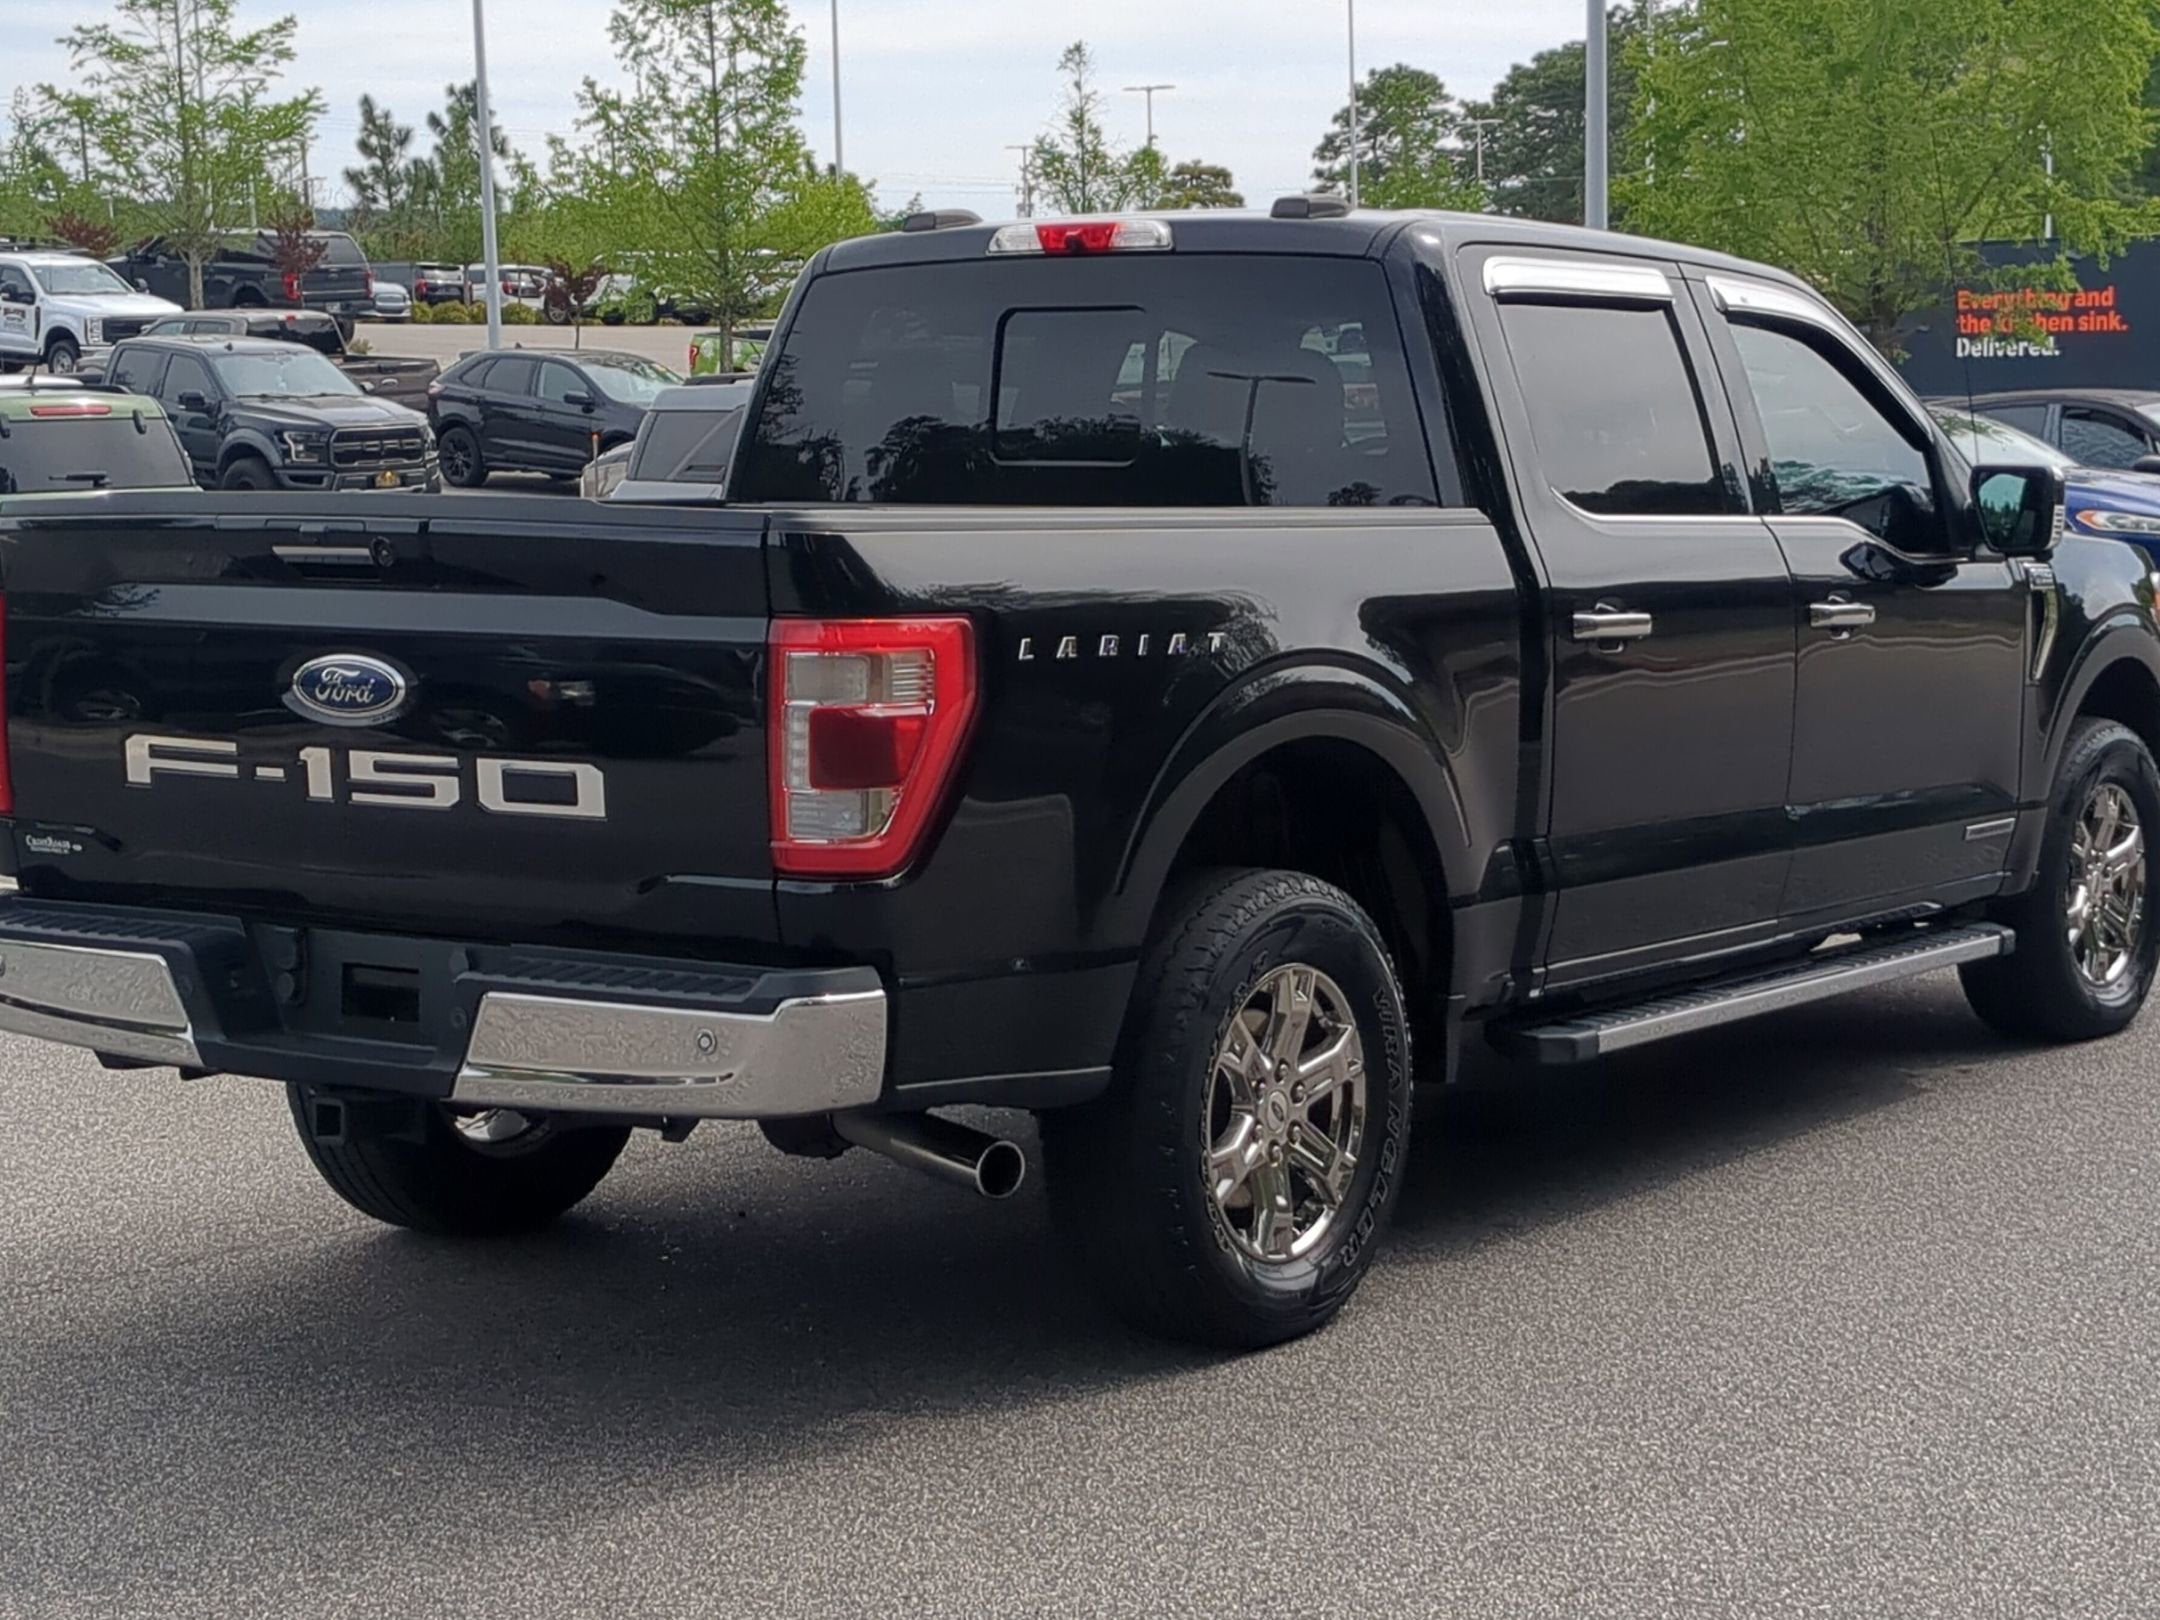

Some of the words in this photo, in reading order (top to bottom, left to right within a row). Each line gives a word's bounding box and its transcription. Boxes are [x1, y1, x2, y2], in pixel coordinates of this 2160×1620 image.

[2075, 286, 2114, 307] and
[1958, 314, 1991, 333] the
[1993, 312, 2076, 333] kihen
[2078, 311, 2128, 331] sink.
[1956, 337, 2061, 357] Delivered.
[1018, 632, 1225, 660] LARIAT
[315, 667, 375, 703] Ford
[125, 734, 607, 820] F-150
[1340, 987, 1401, 1267] WRANGLER
